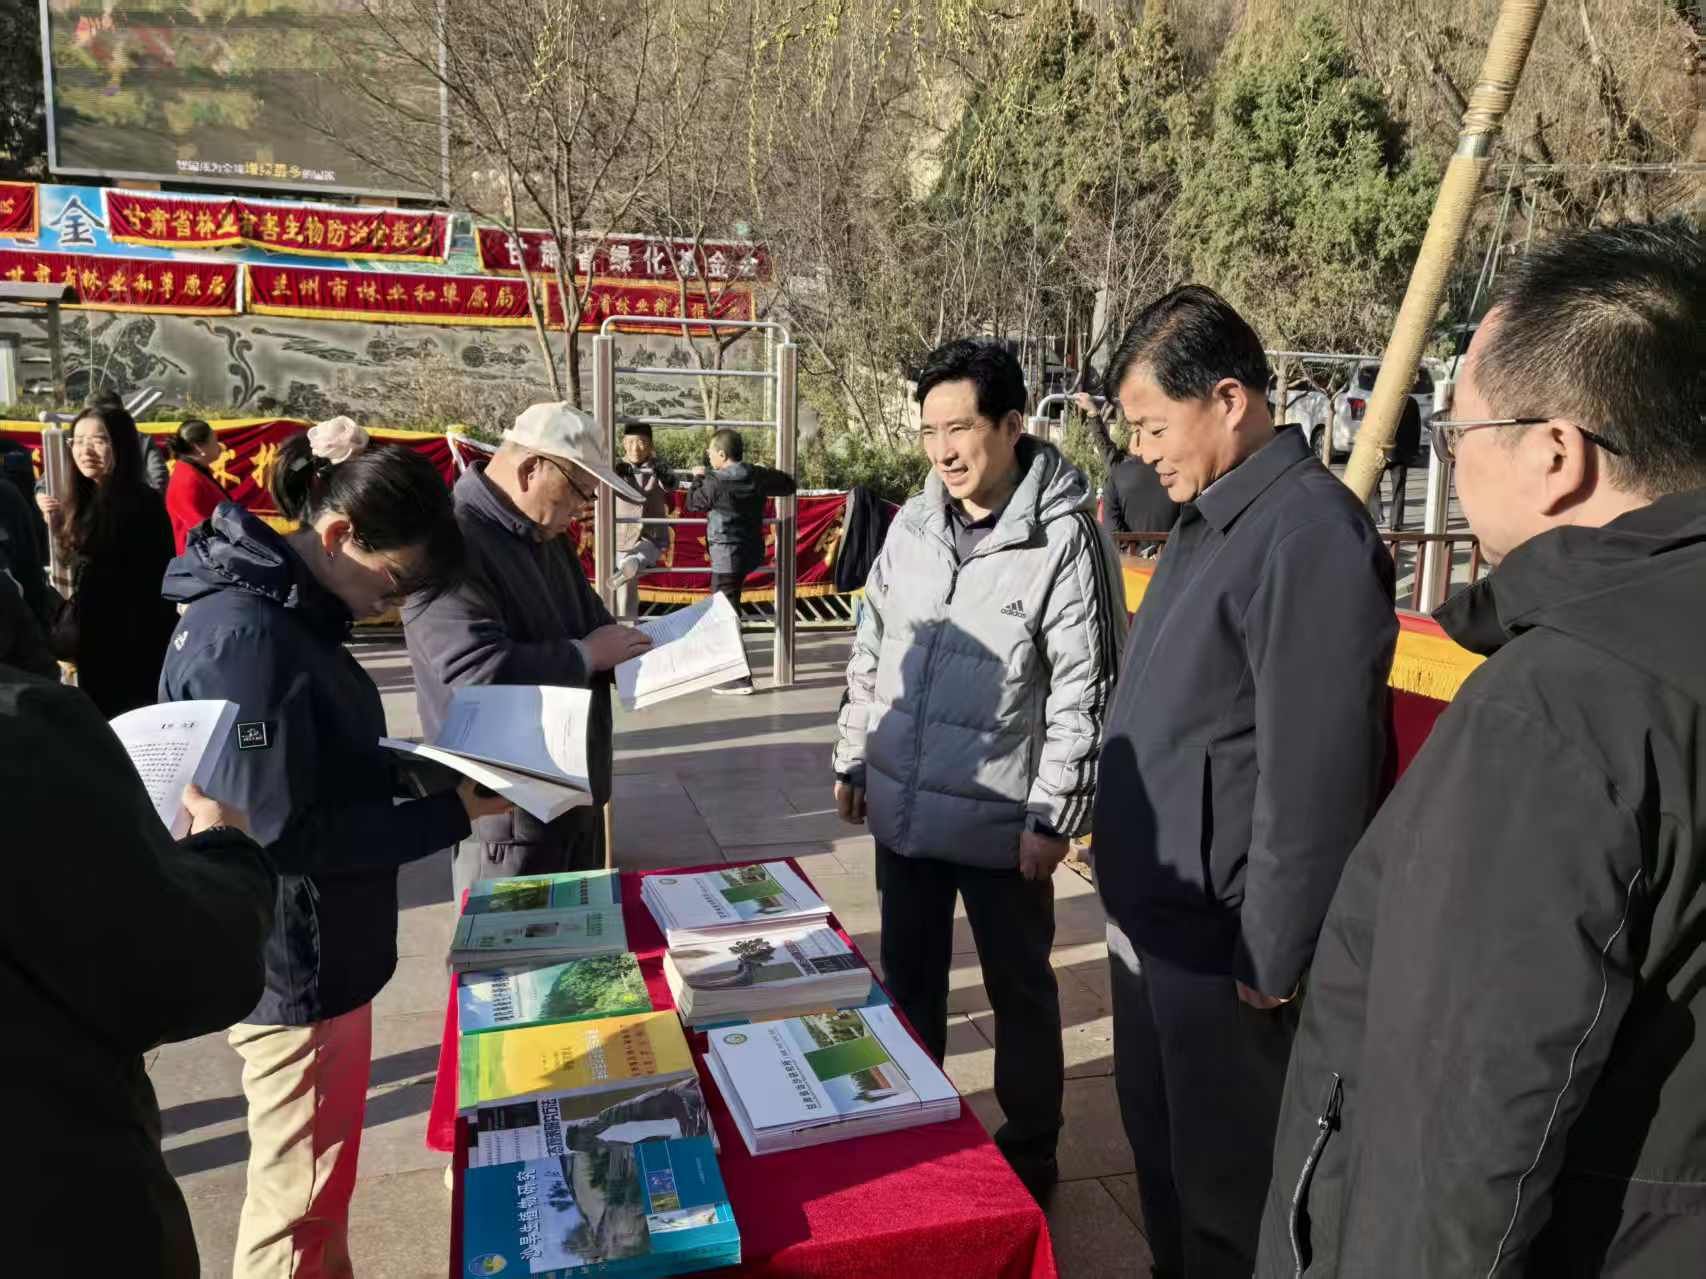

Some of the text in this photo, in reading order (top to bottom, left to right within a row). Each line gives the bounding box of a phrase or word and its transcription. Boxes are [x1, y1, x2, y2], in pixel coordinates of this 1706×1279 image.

[271, 272, 515, 310] 兰州市林业和草原局
